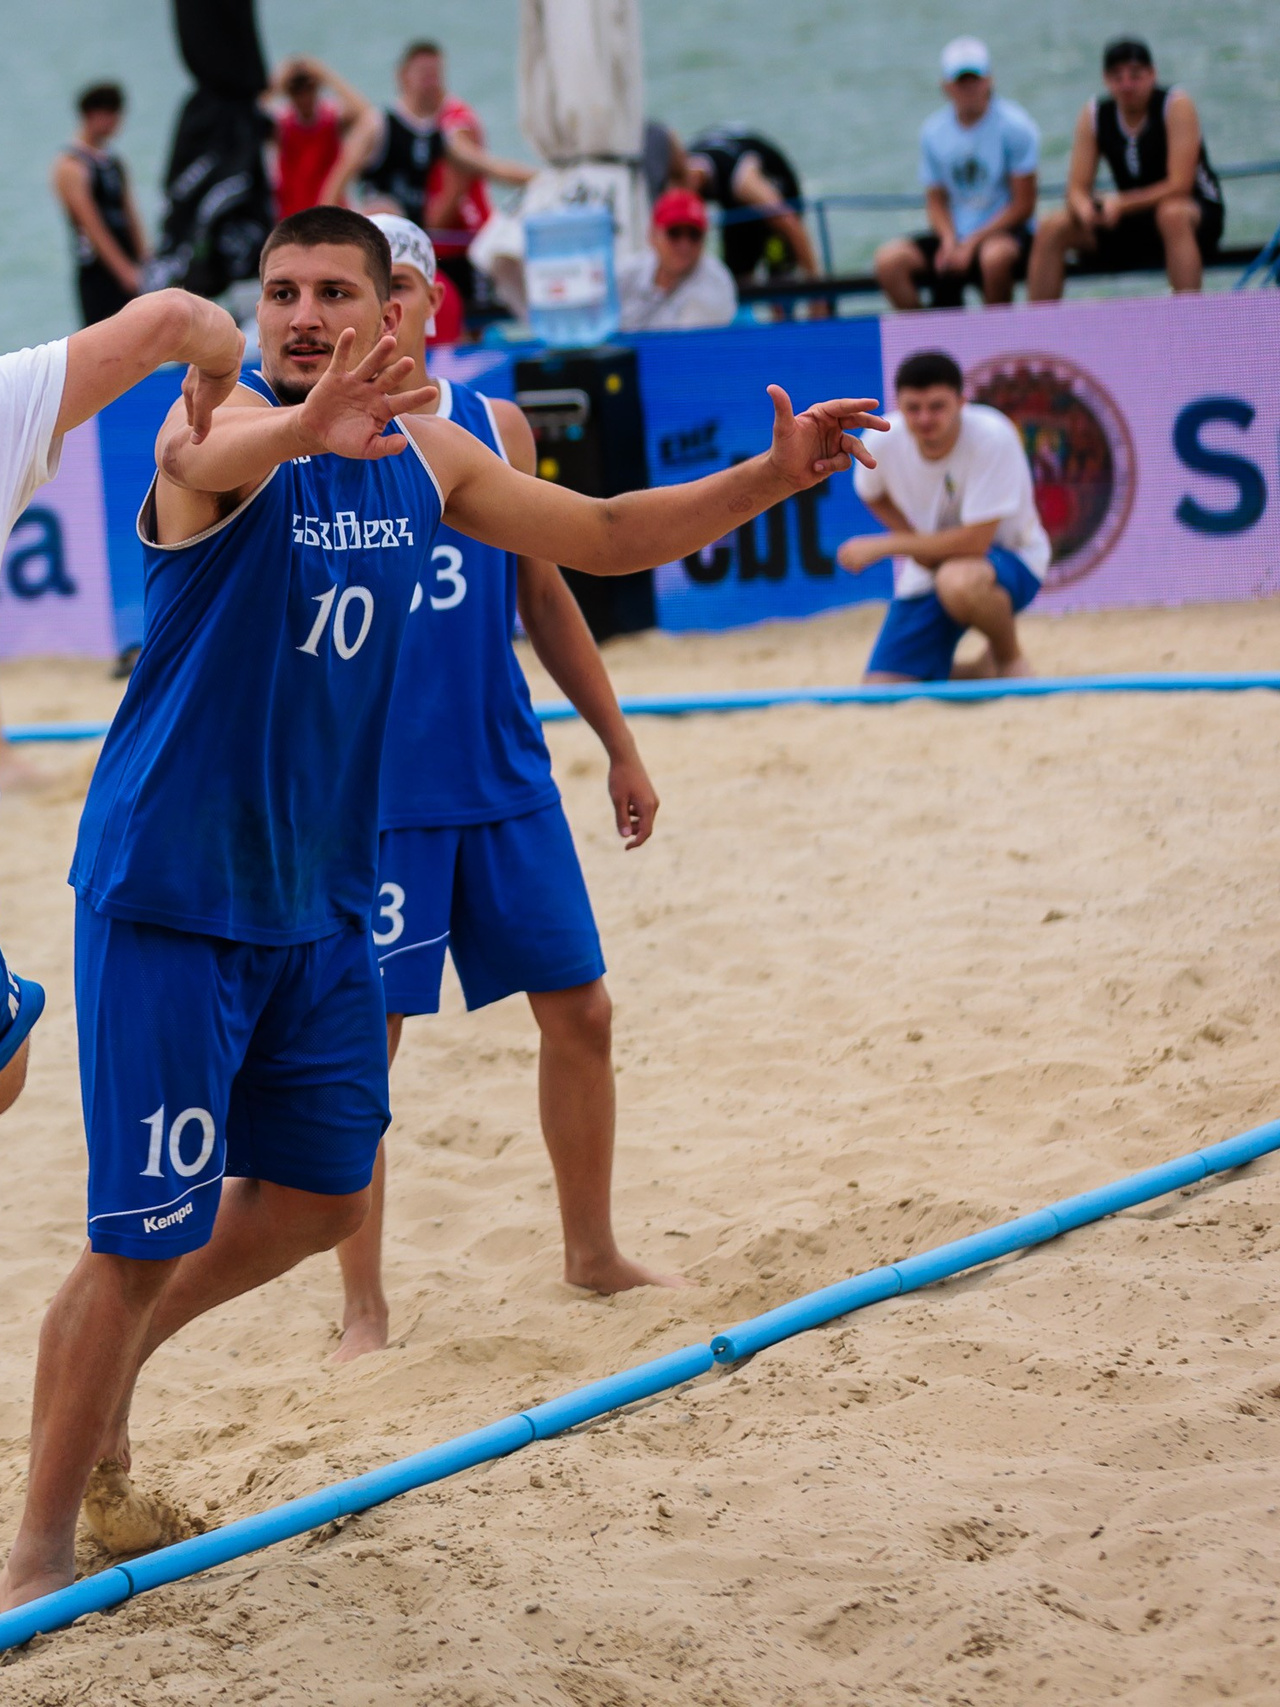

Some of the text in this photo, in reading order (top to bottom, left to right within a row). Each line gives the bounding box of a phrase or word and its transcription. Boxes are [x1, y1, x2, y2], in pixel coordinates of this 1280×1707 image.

[1173, 394, 1280, 537] S
[409, 544, 468, 614] 3
[295, 583, 375, 661] 10
[139, 1103, 216, 1178] 10
[142, 1201, 194, 1234] Kempa
